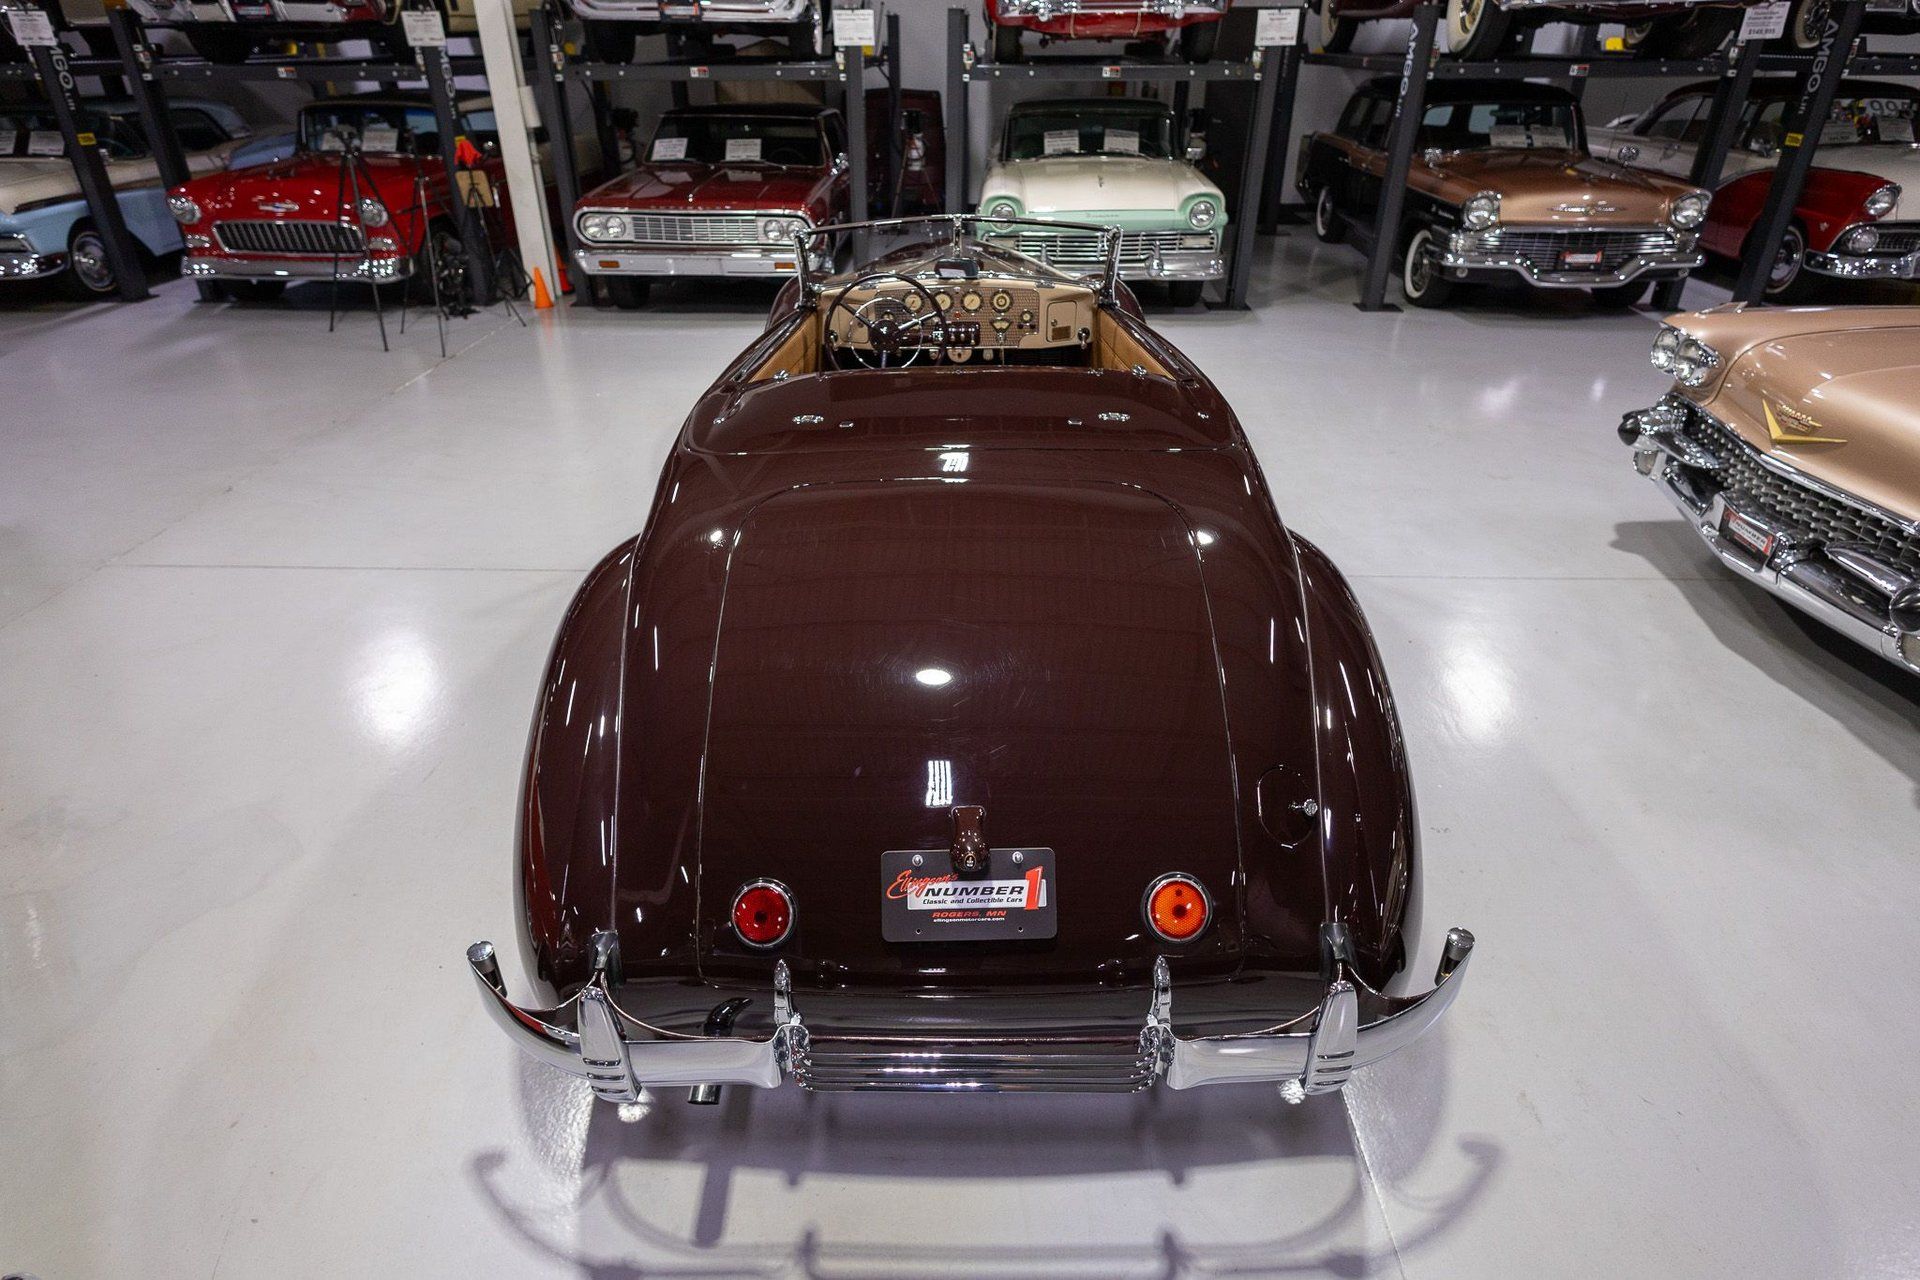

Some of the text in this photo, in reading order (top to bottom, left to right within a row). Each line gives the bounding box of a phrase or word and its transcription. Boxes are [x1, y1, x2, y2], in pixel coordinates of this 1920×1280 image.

[1400, 21, 1420, 97] AMGO
[1807, 18, 1839, 93] AMGO
[924, 865, 1044, 911] NUMBER 1
[966, 896, 1004, 904] Collectible
